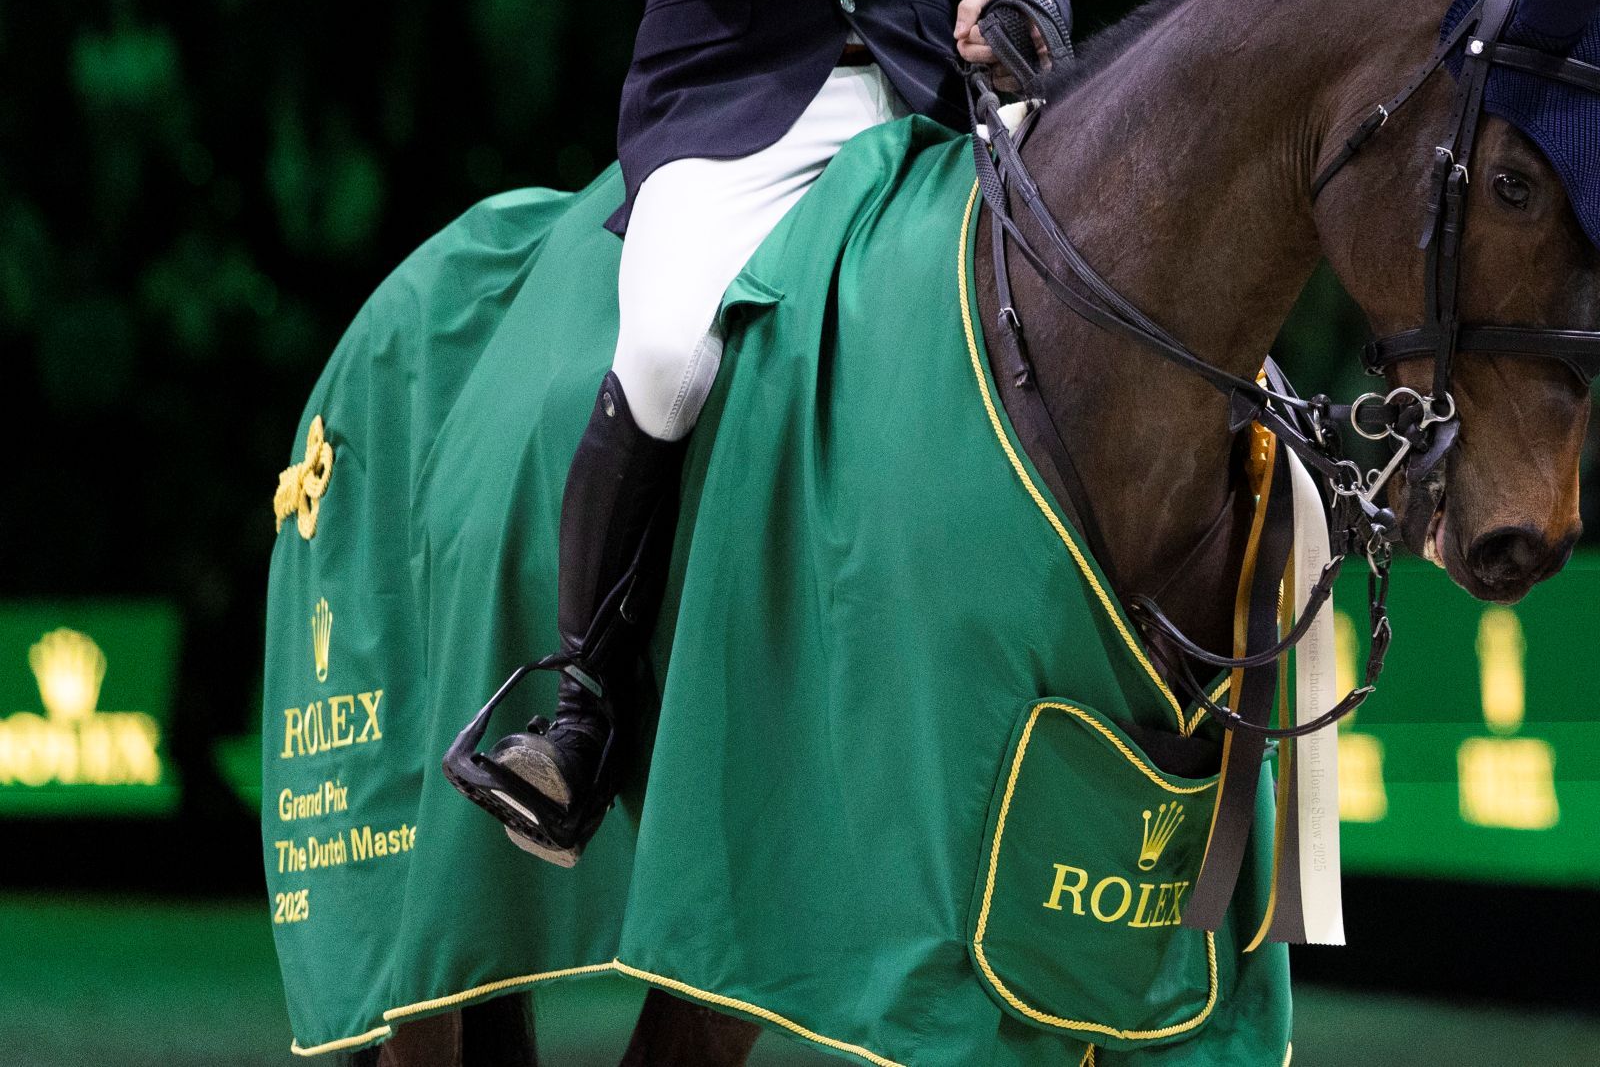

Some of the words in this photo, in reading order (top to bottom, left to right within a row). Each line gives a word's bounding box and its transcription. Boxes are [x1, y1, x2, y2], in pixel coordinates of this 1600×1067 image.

[1308, 546, 1321, 569] The
[1310, 671, 1323, 711] Indoor
[280, 690, 383, 759] ROLEX
[278, 784, 322, 821] Grand
[325, 780, 348, 814] Prix
[1311, 769, 1325, 805] Horse
[1311, 807, 1326, 839] Show
[274, 839, 307, 874] The
[308, 832, 347, 870] Dutch
[1312, 843, 1327, 872] 2025
[274, 889, 309, 924] 2025
[1043, 863, 1189, 928] ROLEX
